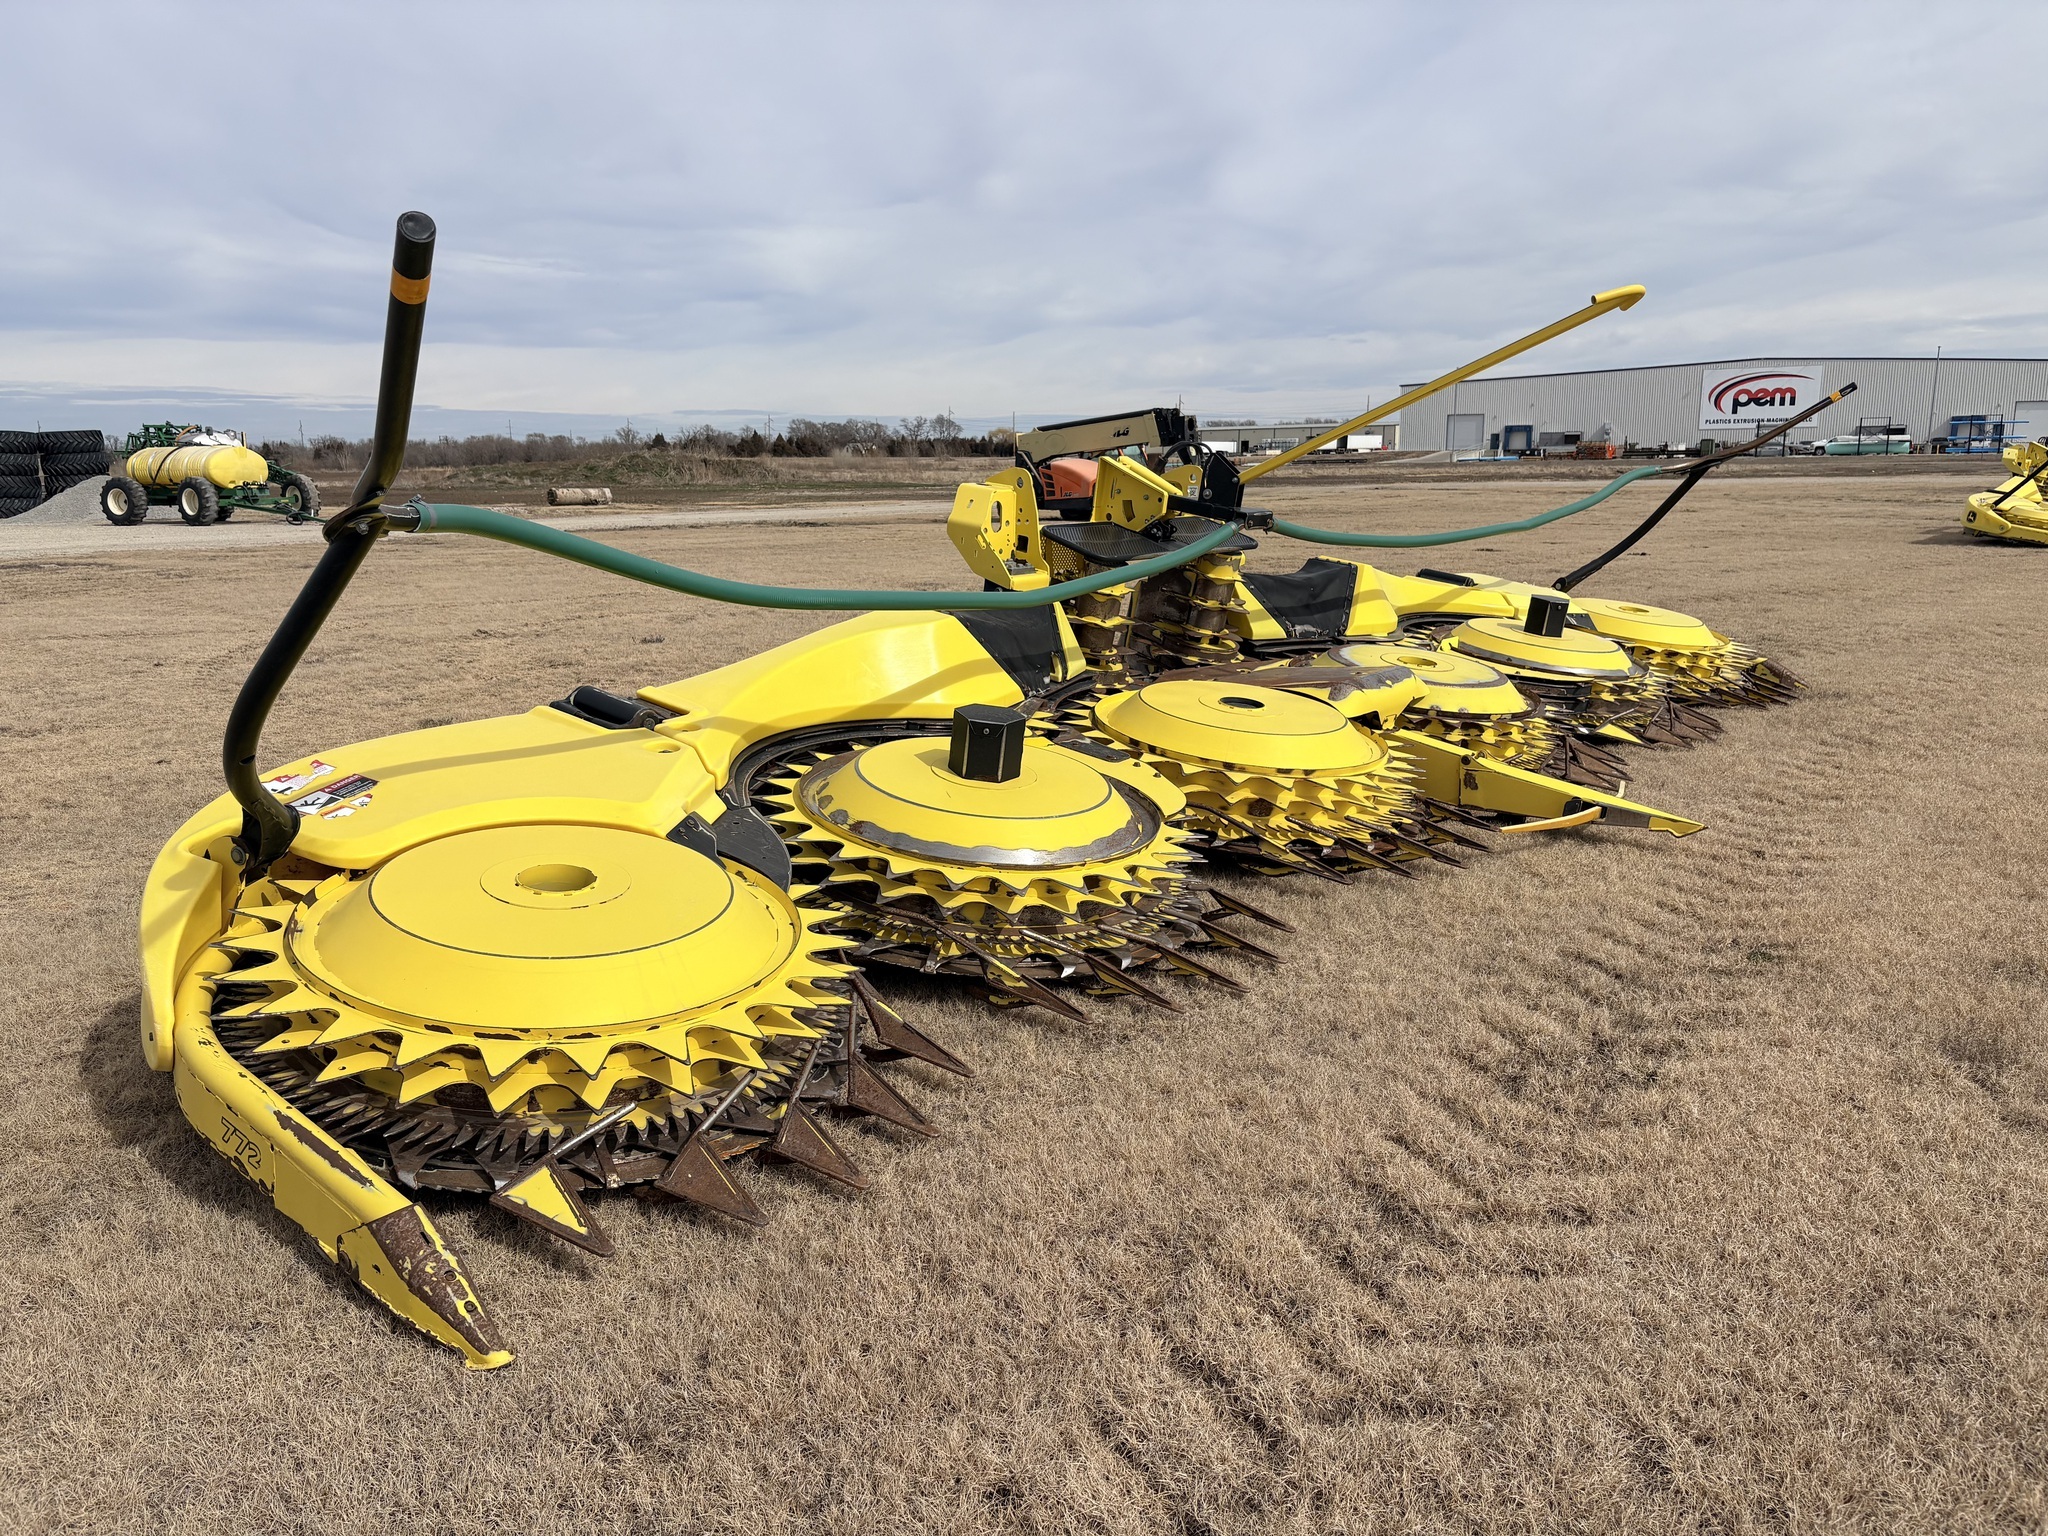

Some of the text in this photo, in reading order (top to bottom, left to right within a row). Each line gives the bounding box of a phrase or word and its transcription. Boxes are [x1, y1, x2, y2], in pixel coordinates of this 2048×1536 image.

[1731, 387, 1797, 415] pem
[331, 774, 361, 789] DANGER
[221, 1115, 262, 1170] 772
